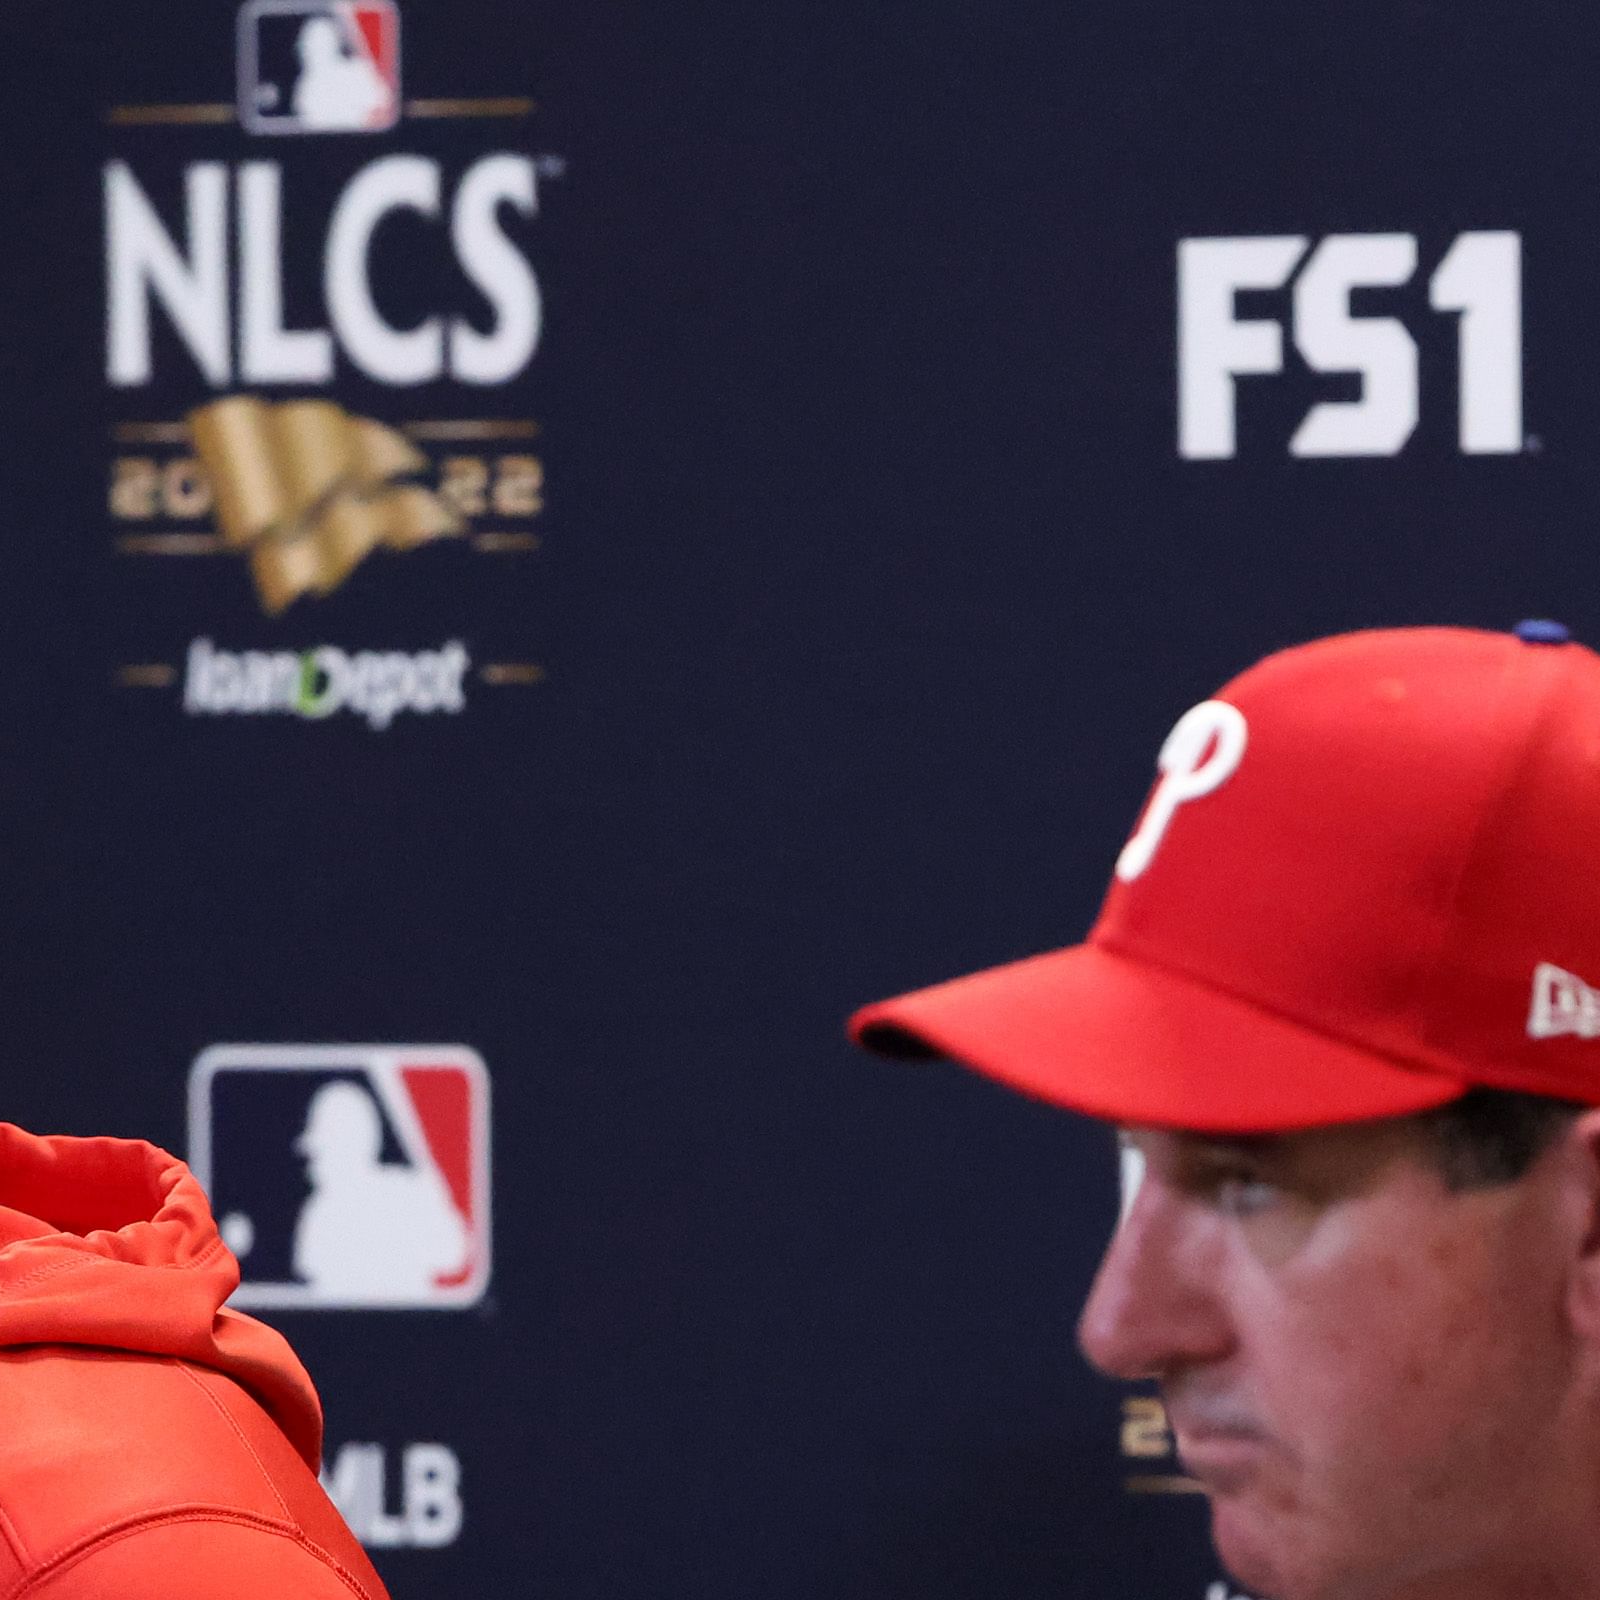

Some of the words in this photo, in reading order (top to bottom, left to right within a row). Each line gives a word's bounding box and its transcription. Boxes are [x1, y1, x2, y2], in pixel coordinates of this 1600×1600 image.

[104, 153, 543, 387] NLCS
[1176, 229, 1523, 460] FS1
[1115, 700, 1247, 881] P
[1120, 1399, 1169, 1456] 2
